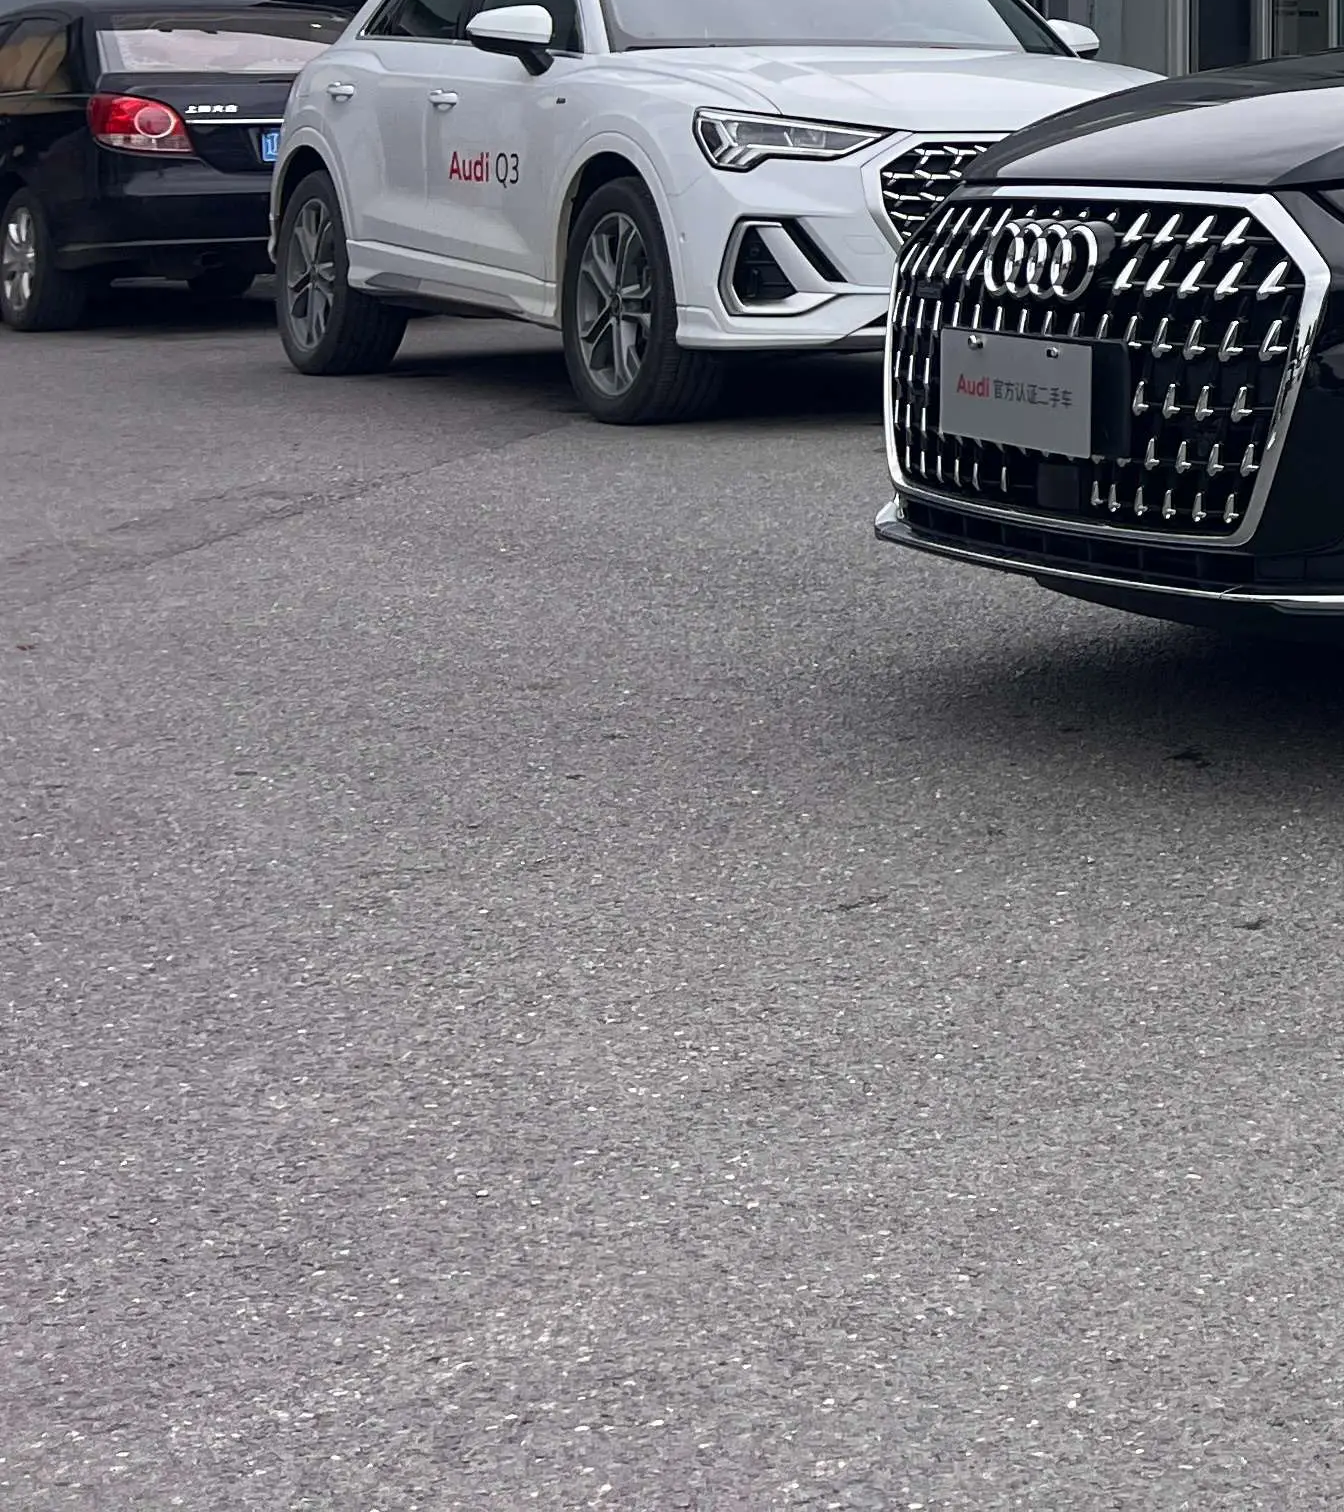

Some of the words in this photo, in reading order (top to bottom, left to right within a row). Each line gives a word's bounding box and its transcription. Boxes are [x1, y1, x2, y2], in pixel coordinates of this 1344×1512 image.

[448, 151, 490, 182] Audi
[495, 152, 520, 189] Q3
[956, 373, 990, 397] Audi
[993, 378, 1073, 409] 官方认证二手车
